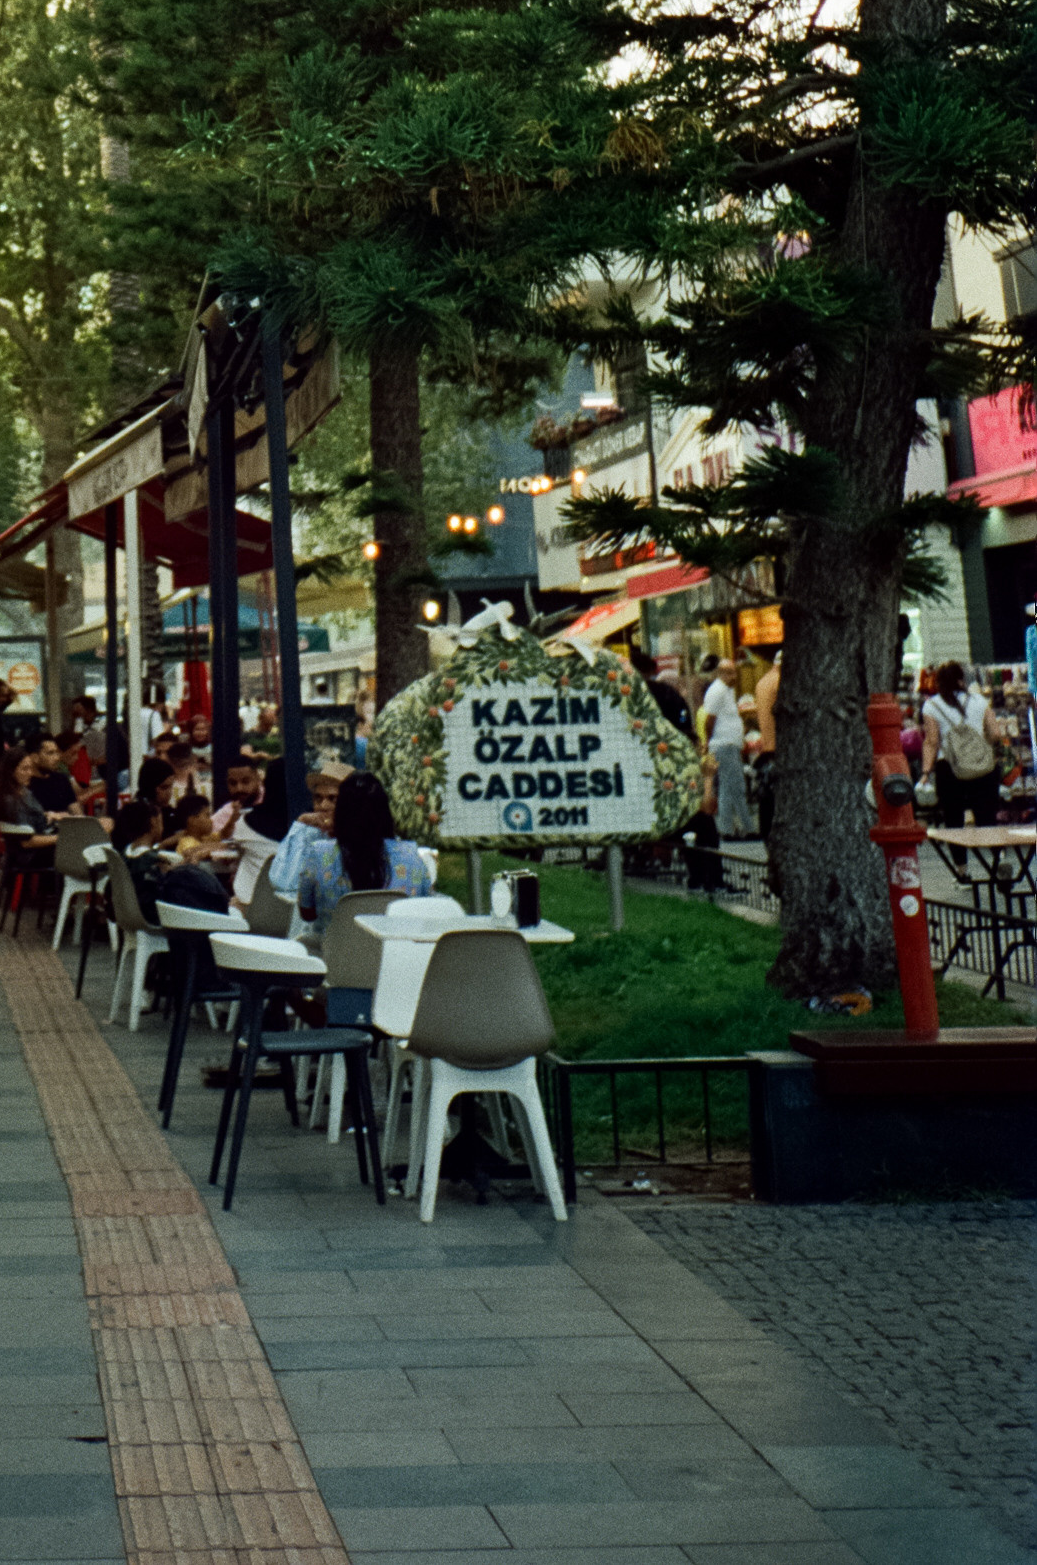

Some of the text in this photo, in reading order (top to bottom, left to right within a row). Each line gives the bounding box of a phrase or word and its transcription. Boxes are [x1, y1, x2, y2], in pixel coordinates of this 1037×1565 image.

[473, 729, 602, 764] ÖZALP
[457, 762, 625, 801] CADDESİ
[538, 806, 589, 827] 2011
